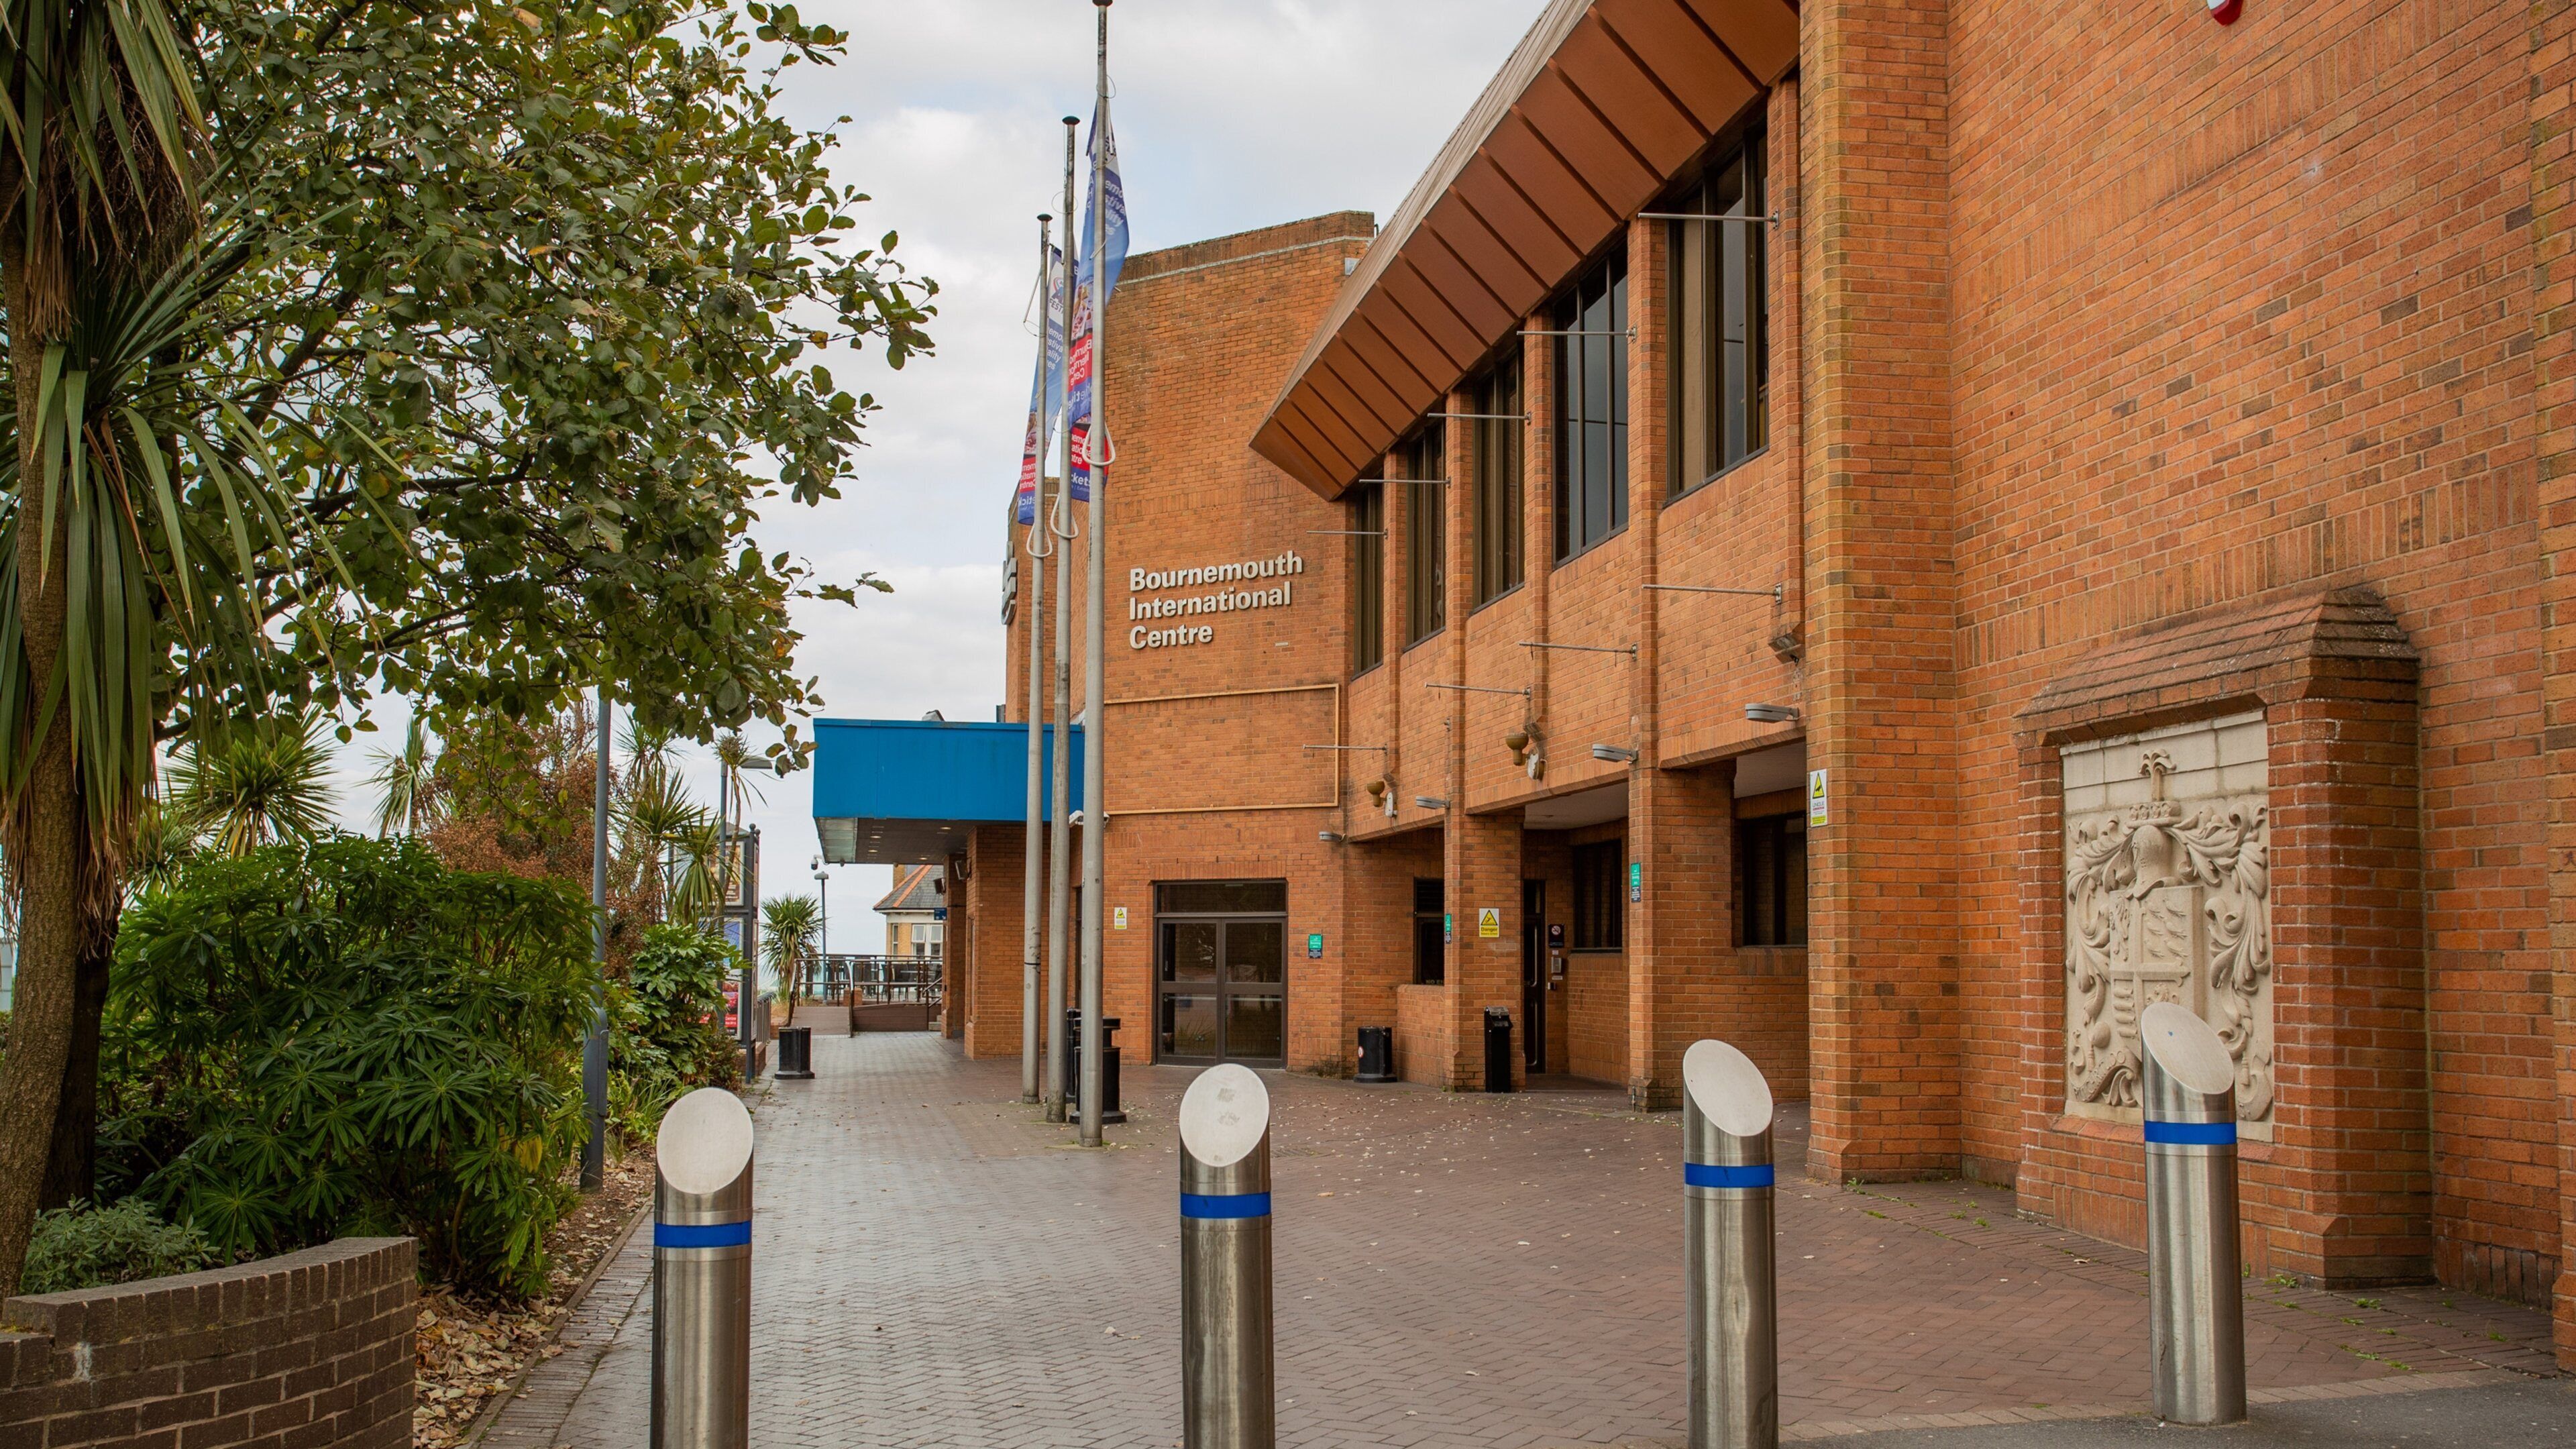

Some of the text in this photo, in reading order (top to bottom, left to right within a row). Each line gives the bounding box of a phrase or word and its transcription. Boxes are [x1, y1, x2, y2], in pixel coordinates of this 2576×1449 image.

[1130, 550, 1303, 592] Bournemouth
[1129, 581, 1291, 621] International
[1129, 624, 1214, 649] Centre
